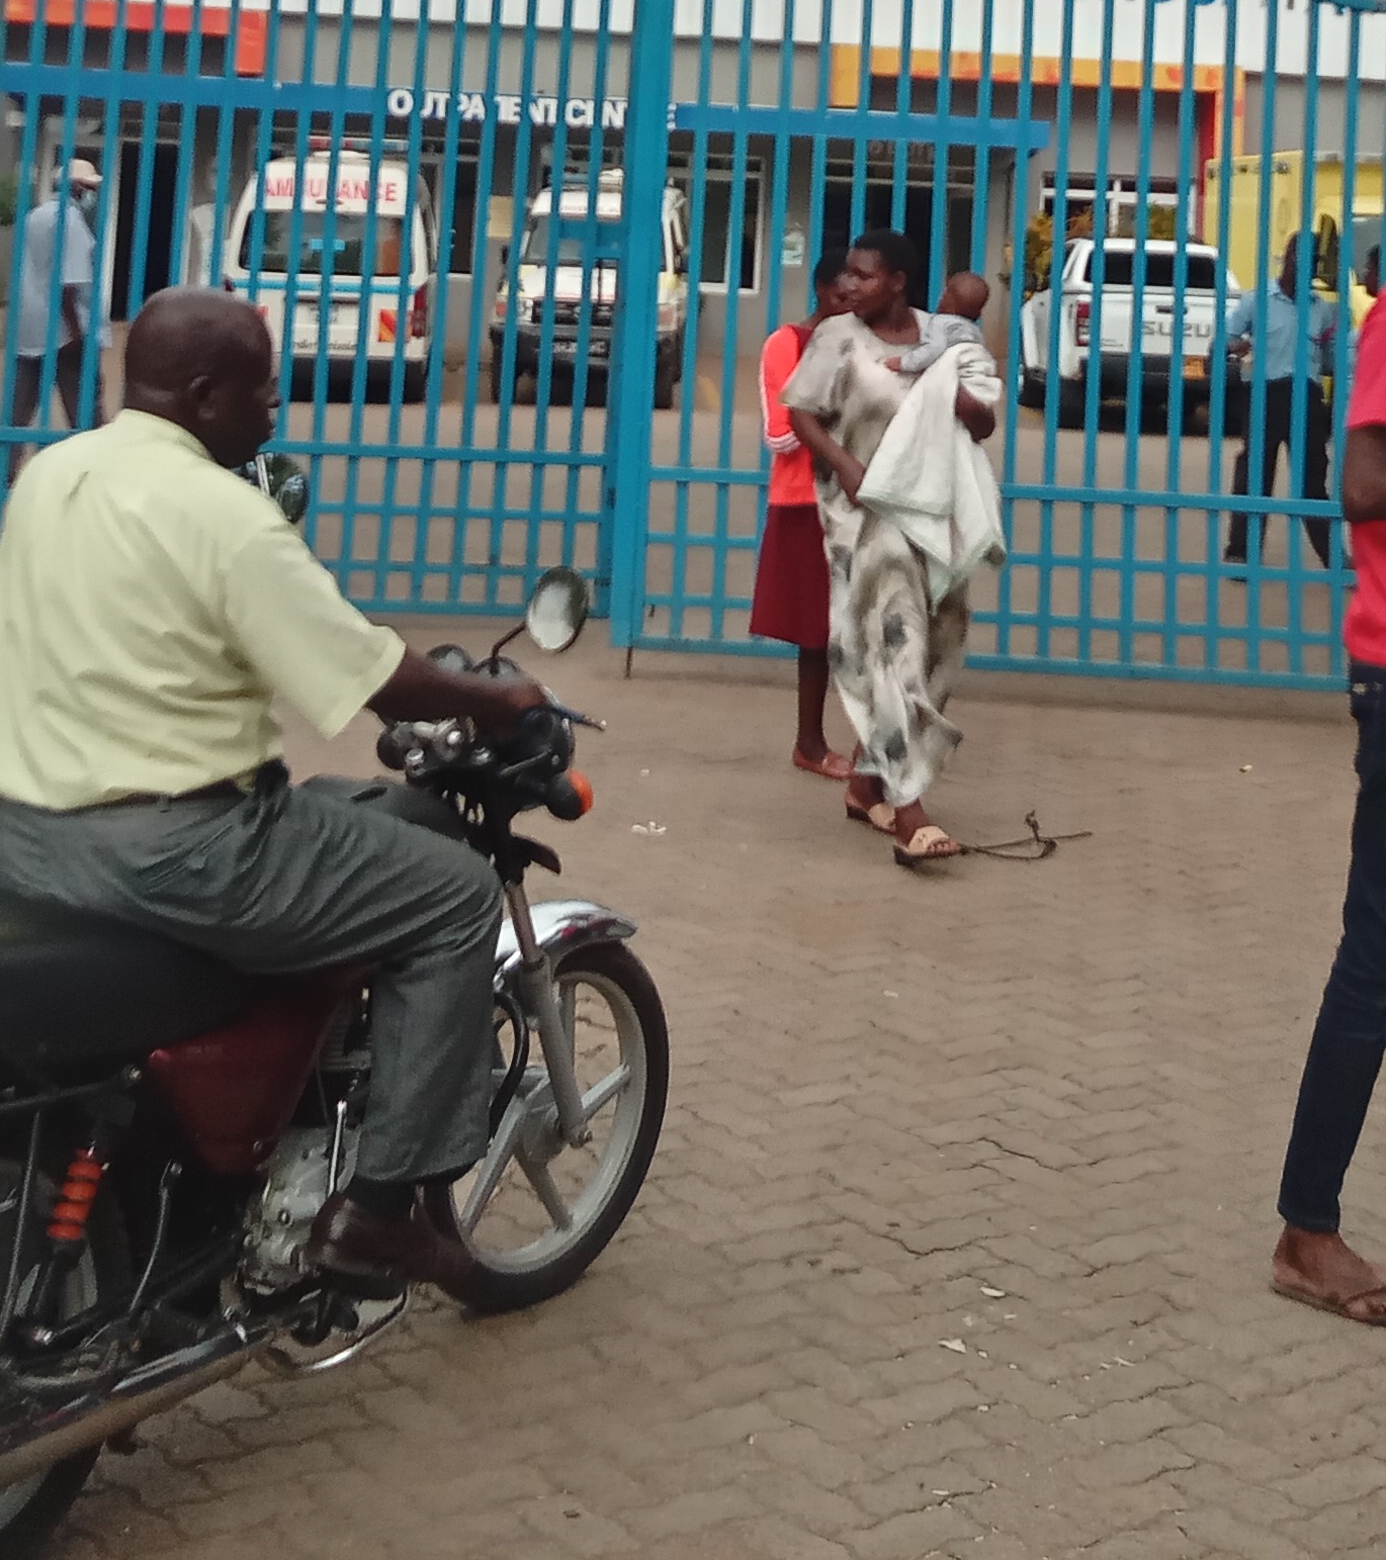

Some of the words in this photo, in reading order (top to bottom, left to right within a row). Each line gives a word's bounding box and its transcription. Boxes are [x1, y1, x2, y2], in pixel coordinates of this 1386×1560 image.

[387, 88, 558, 126] OUTPAIENT
[265, 176, 398, 203] AMUANE
[1136, 321, 1212, 338] SUZU
